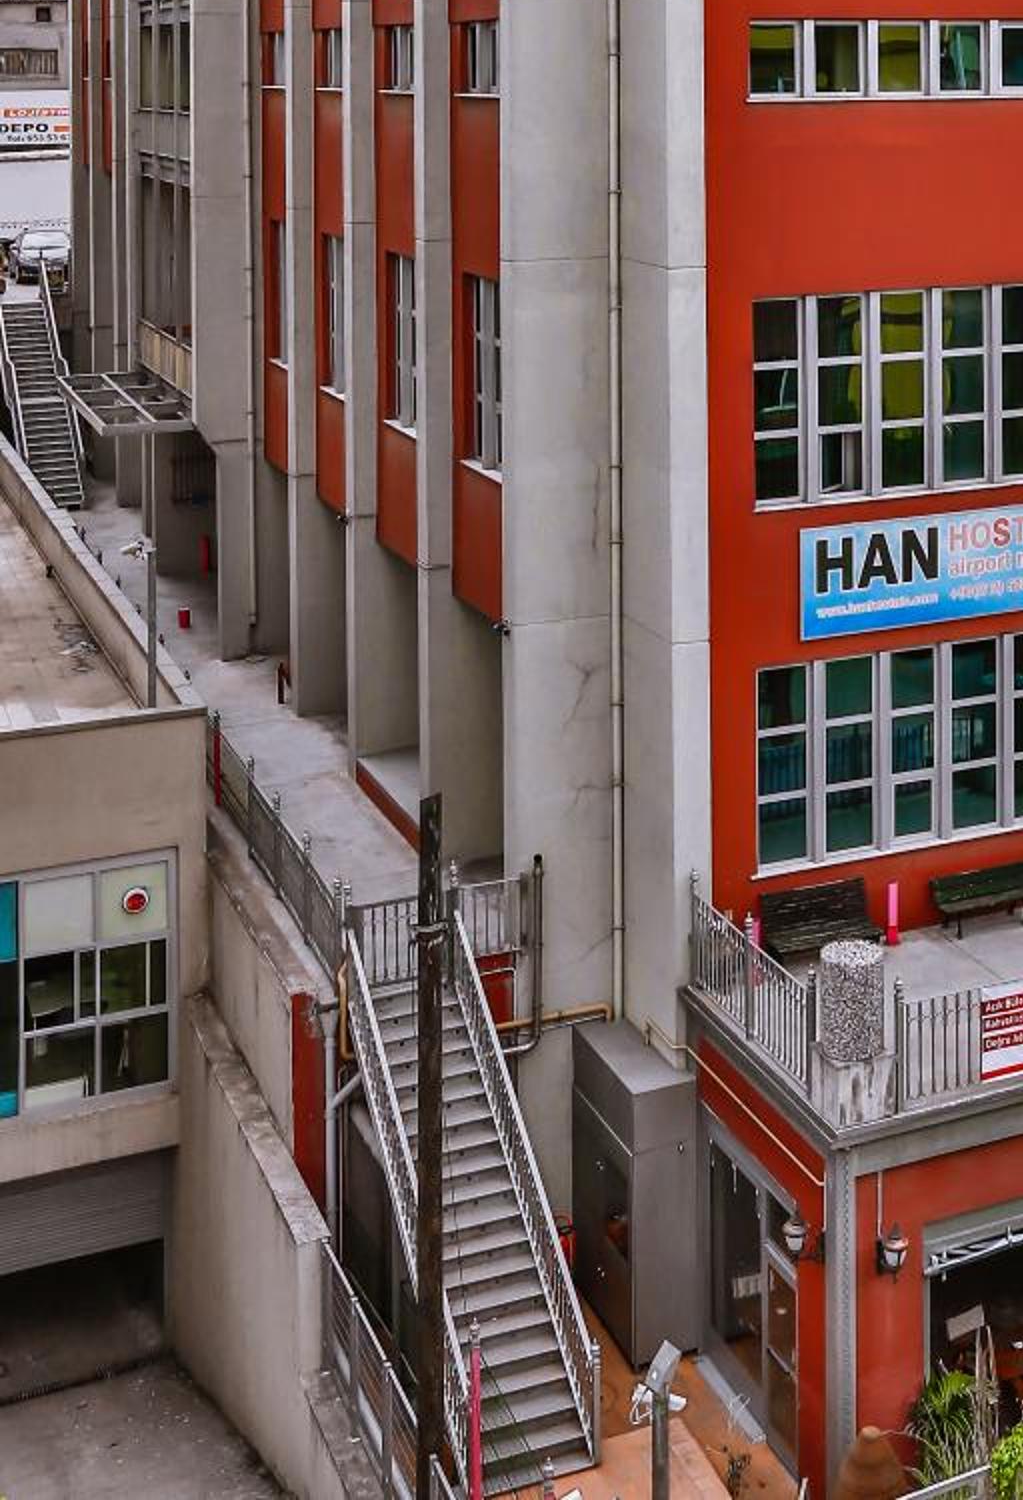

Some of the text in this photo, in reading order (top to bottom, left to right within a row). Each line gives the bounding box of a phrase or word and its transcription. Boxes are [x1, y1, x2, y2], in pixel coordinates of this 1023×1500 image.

[0, 123, 48, 132] DEPO
[815, 526, 939, 594] HAN
[949, 552, 1012, 579] airport
